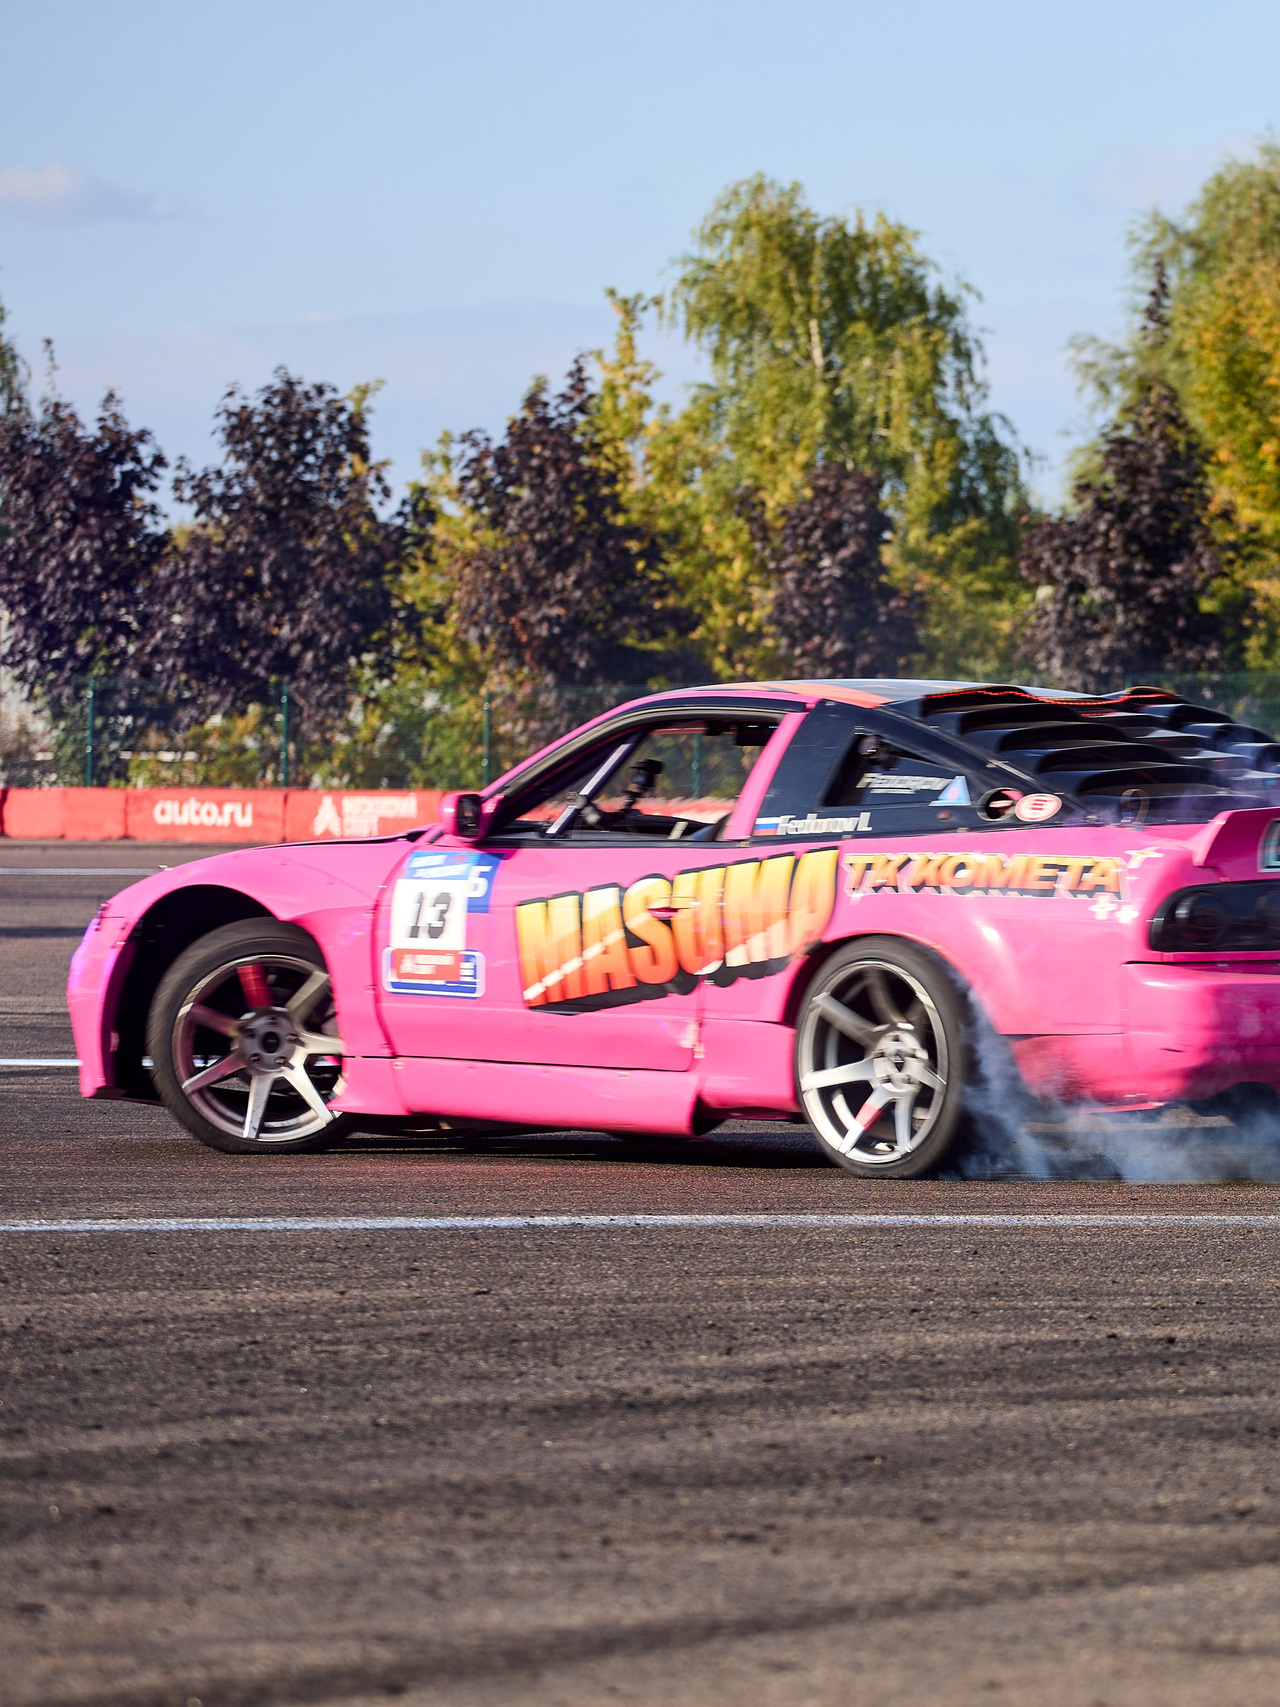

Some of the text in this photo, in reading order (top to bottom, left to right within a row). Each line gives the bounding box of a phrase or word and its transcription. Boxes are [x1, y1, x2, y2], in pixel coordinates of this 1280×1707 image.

[154, 797, 252, 827] auto.ru
[407, 891, 451, 939] 13
[516, 848, 838, 1010] MASUMA
